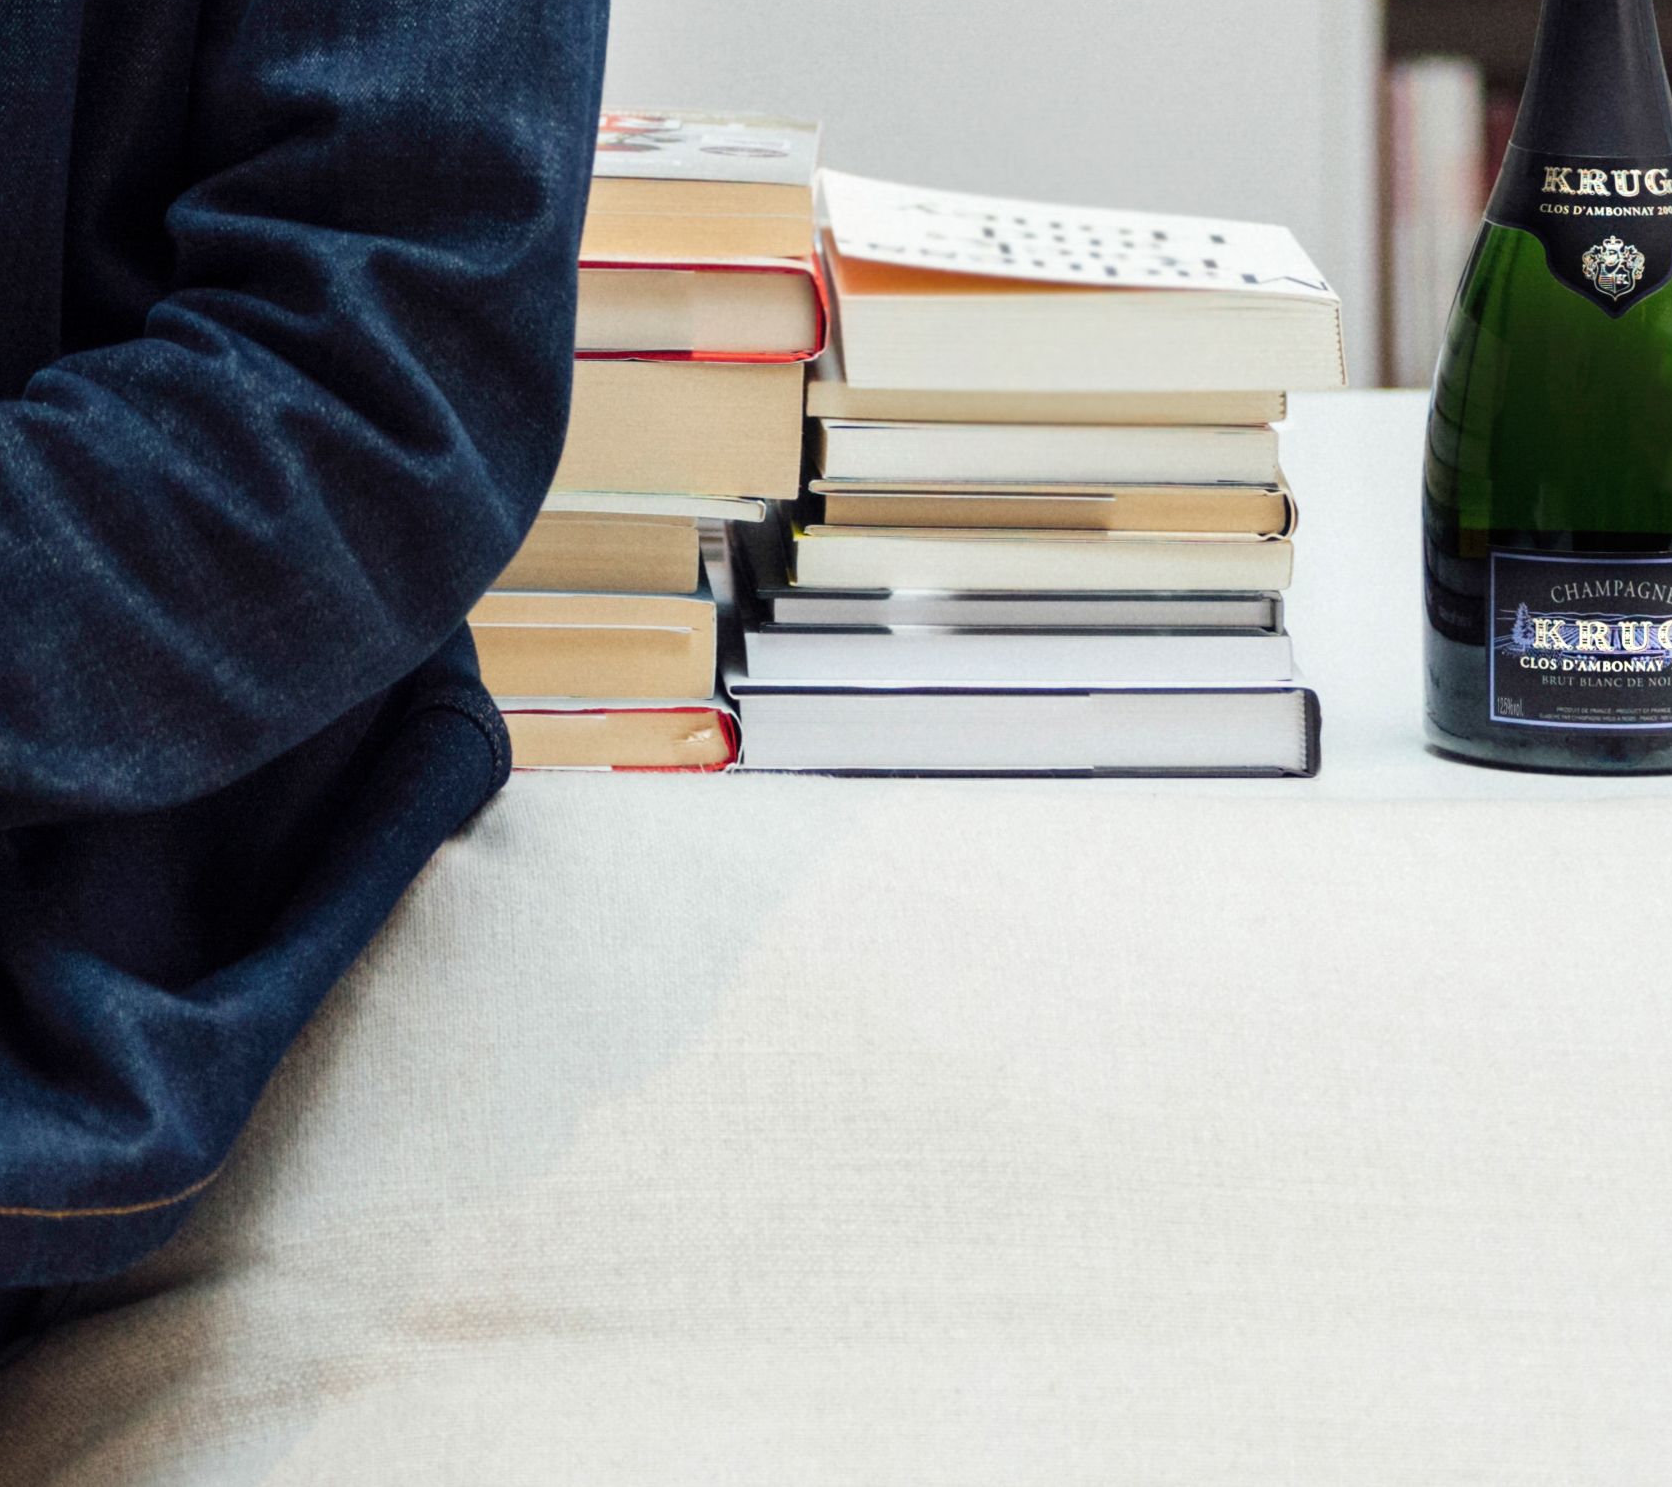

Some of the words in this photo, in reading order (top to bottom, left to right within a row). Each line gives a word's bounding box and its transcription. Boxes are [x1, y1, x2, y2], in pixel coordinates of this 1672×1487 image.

[1539, 203, 1570, 215] CLOS
[1573, 205, 1654, 217] D'AMBONNAY
[1520, 656, 1557, 670] CLOS
[1562, 657, 1664, 673] D'AMBONNAY
[1542, 675, 1574, 686] BRUT
[1580, 677, 1623, 687] BLANC
[1627, 677, 1644, 687] DE
